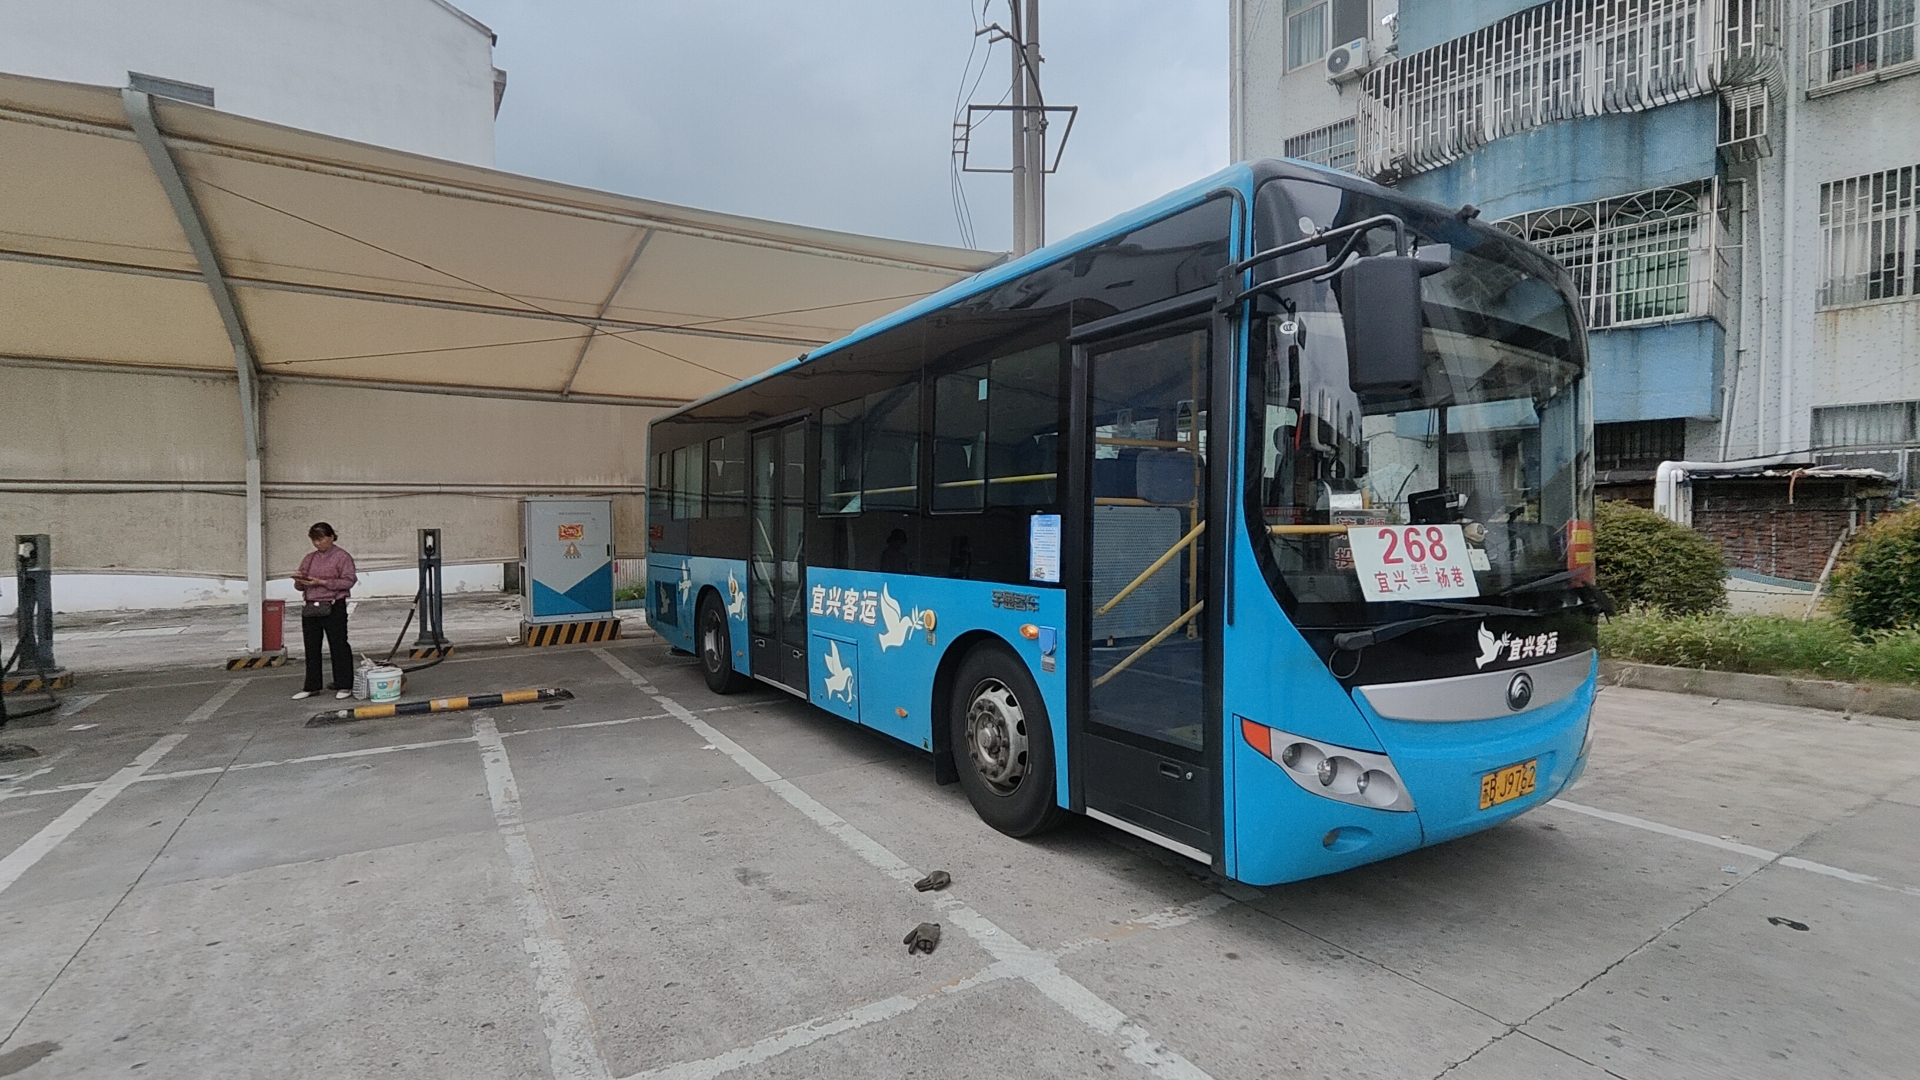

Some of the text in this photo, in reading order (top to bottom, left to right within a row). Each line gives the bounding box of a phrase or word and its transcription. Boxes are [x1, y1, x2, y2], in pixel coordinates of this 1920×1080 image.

[1378, 526, 1447, 565] 268
[1374, 565, 1465, 593] 宜兴 杨巷
[810, 583, 878, 625] 宜兴客运
[991, 589, 1040, 613] 宇通客车
[1507, 631, 1559, 662] 宜兴客运
